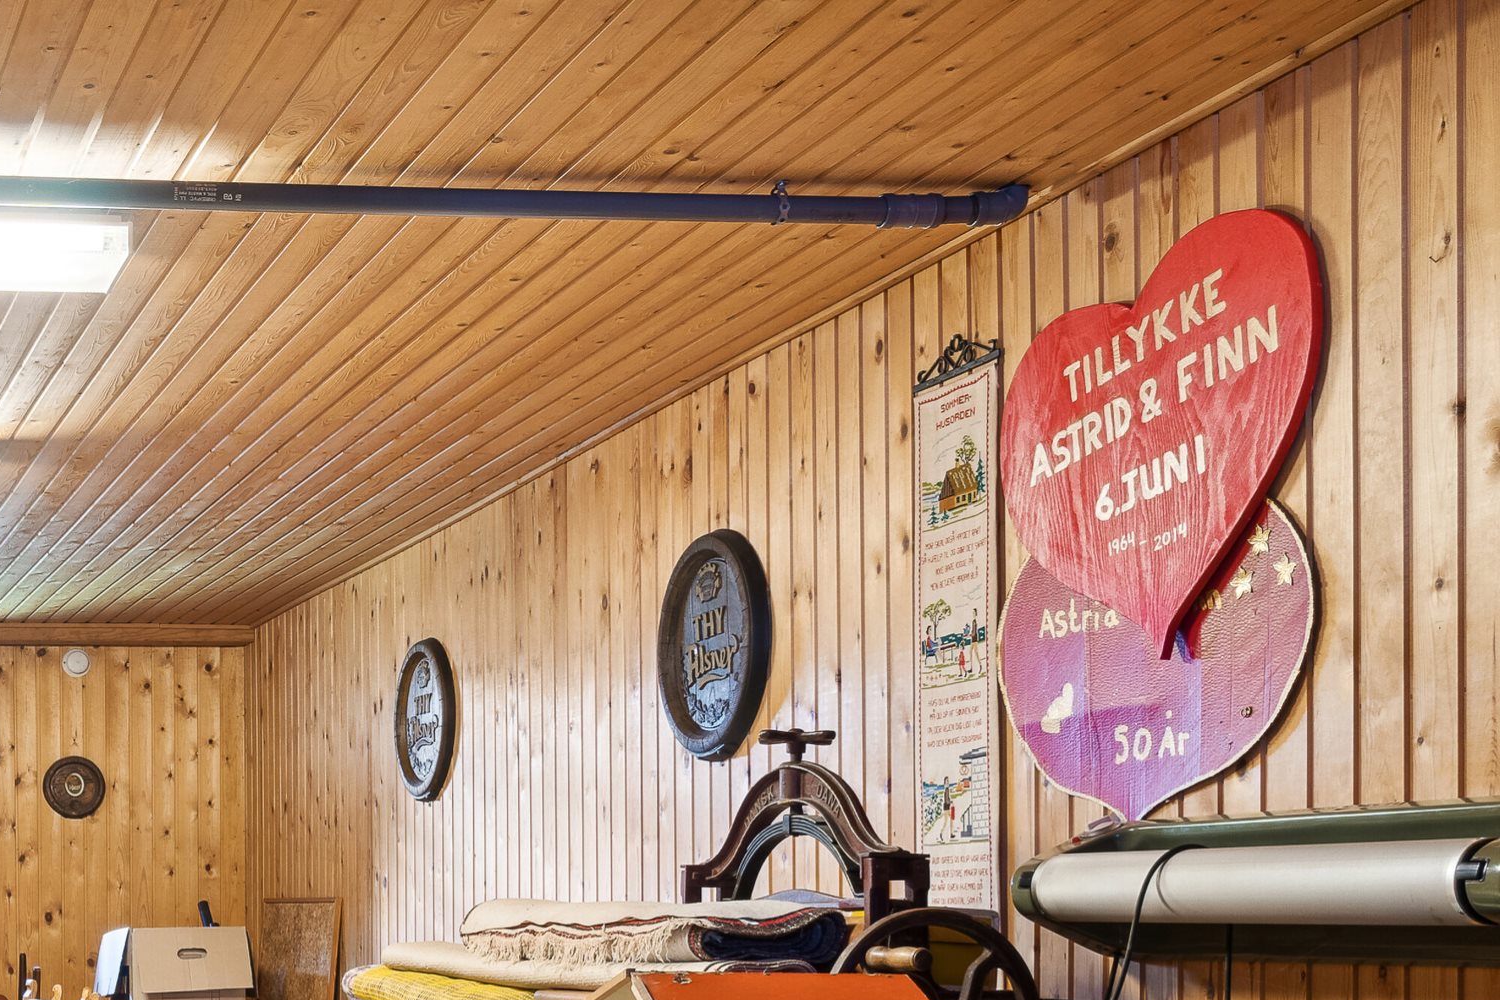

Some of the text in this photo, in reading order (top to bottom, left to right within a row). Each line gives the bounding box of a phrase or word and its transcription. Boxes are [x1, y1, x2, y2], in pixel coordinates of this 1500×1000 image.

[1063, 268, 1227, 402] TILLYKKE
[940, 393, 972, 414] SOMMER-
[1029, 305, 1280, 488] ASTRID & FINN
[935, 406, 976, 431] HUSORDEN
[1107, 530, 1136, 557] 1964
[1153, 522, 1188, 552] 2014
[692, 606, 727, 642] THY
[685, 634, 741, 689] Pilsner
[414, 692, 433, 717] THY
[1113, 710, 1190, 766] 50 År
[816, 784, 841, 819] DANA
